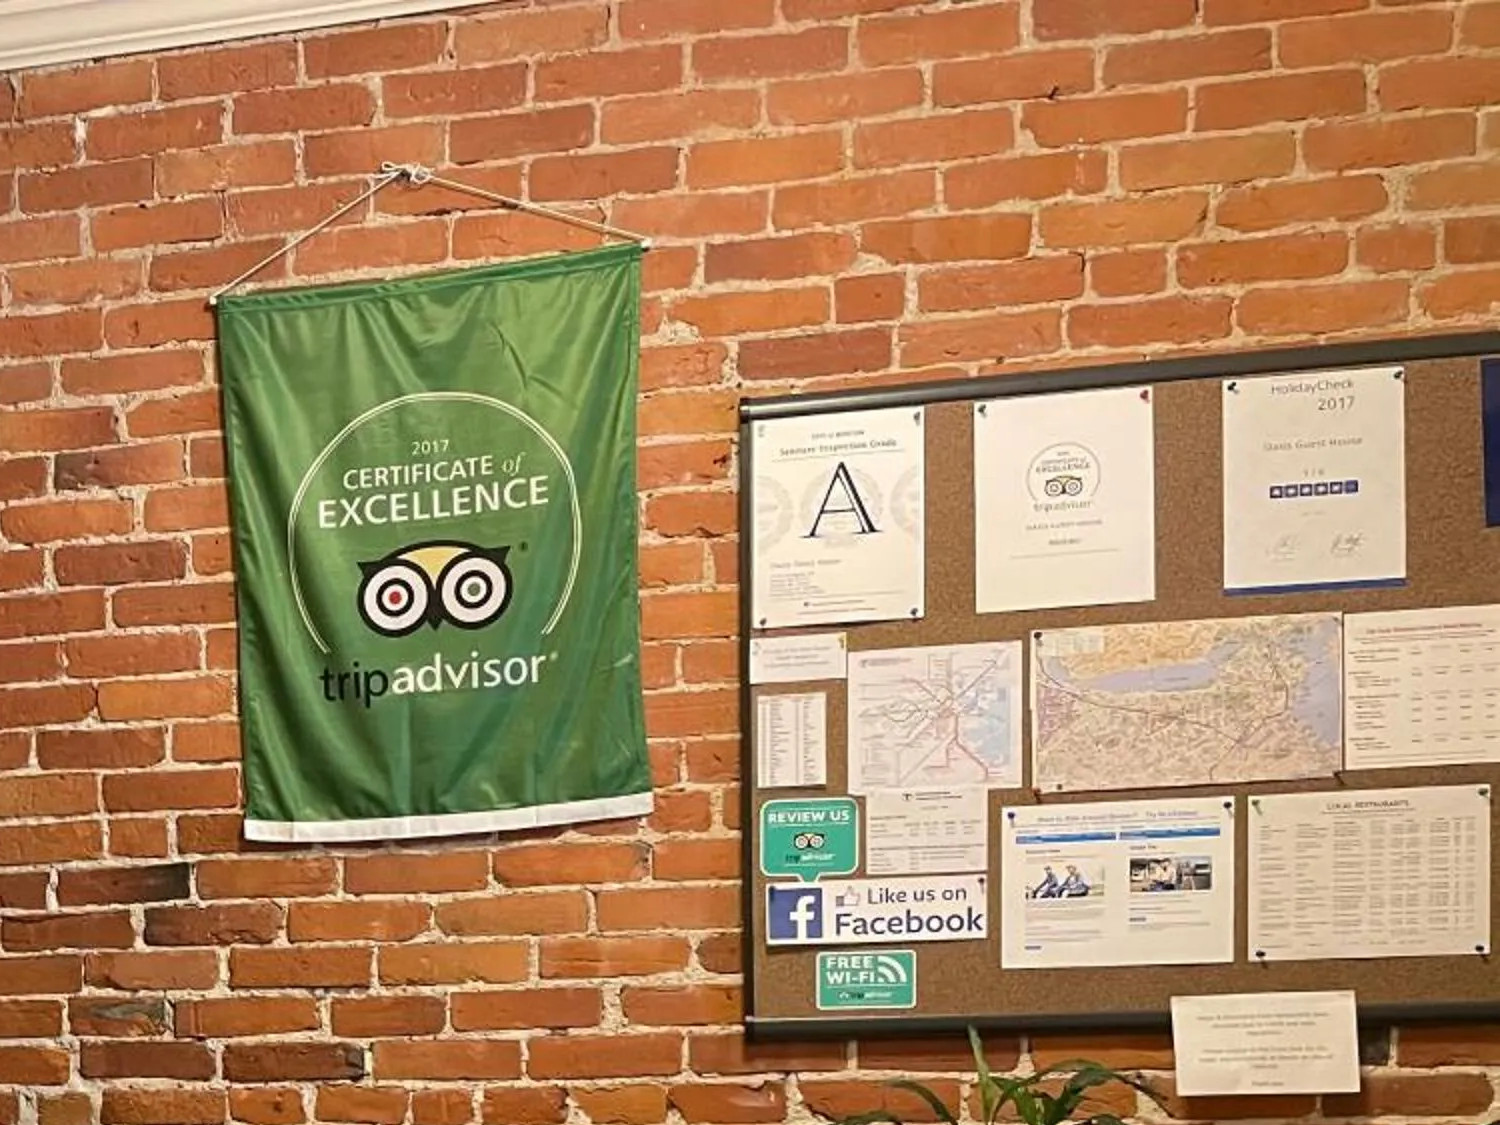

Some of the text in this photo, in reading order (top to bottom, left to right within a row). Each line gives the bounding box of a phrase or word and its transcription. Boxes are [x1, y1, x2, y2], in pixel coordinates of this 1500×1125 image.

[1271, 378, 1354, 395] HolidayCheck
[1317, 395, 1355, 411] 2017
[411, 440, 450, 455] 2017
[342, 451, 527, 491] CERTIFICATE of
[318, 475, 550, 530] EXCELLENCE
[798, 460, 886, 539] A
[320, 651, 544, 708] tripadvisor
[767, 810, 850, 825] REVIEW US
[867, 887, 907, 905] Like
[913, 888, 935, 902] us
[941, 887, 967, 901] on
[835, 906, 984, 937] Facebook
[826, 955, 874, 969] FREE
[826, 971, 875, 985] WI-FI
